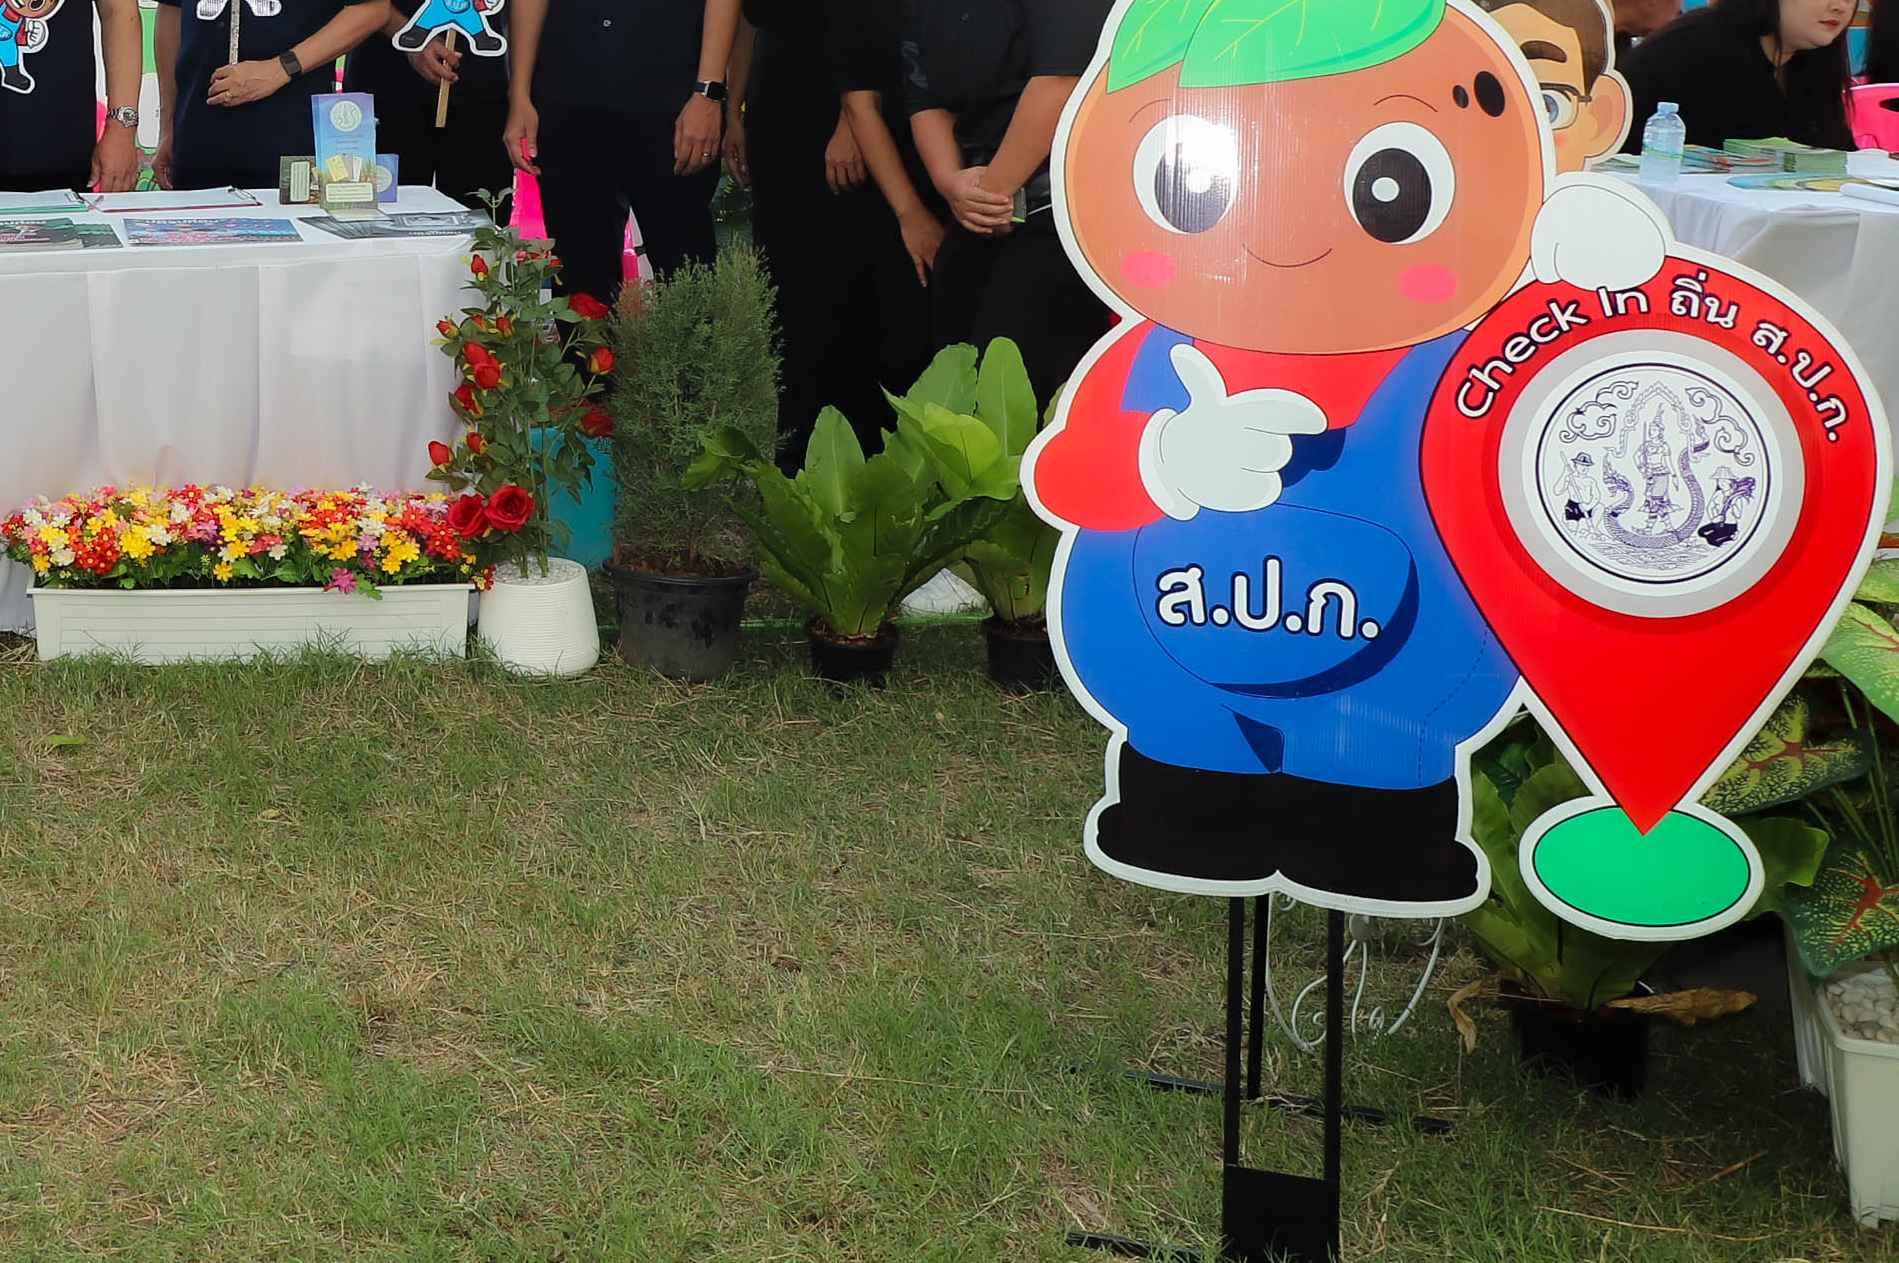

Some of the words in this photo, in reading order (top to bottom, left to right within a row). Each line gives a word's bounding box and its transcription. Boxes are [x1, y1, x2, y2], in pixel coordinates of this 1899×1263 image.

[1456, 299, 1589, 420] Check
[1597, 286, 1650, 319] In
[1670, 270, 1741, 330] ถิ่น
[1751, 319, 1850, 443] ส.ป.ก.
[1156, 556, 1382, 642] ส.ป.ก.
